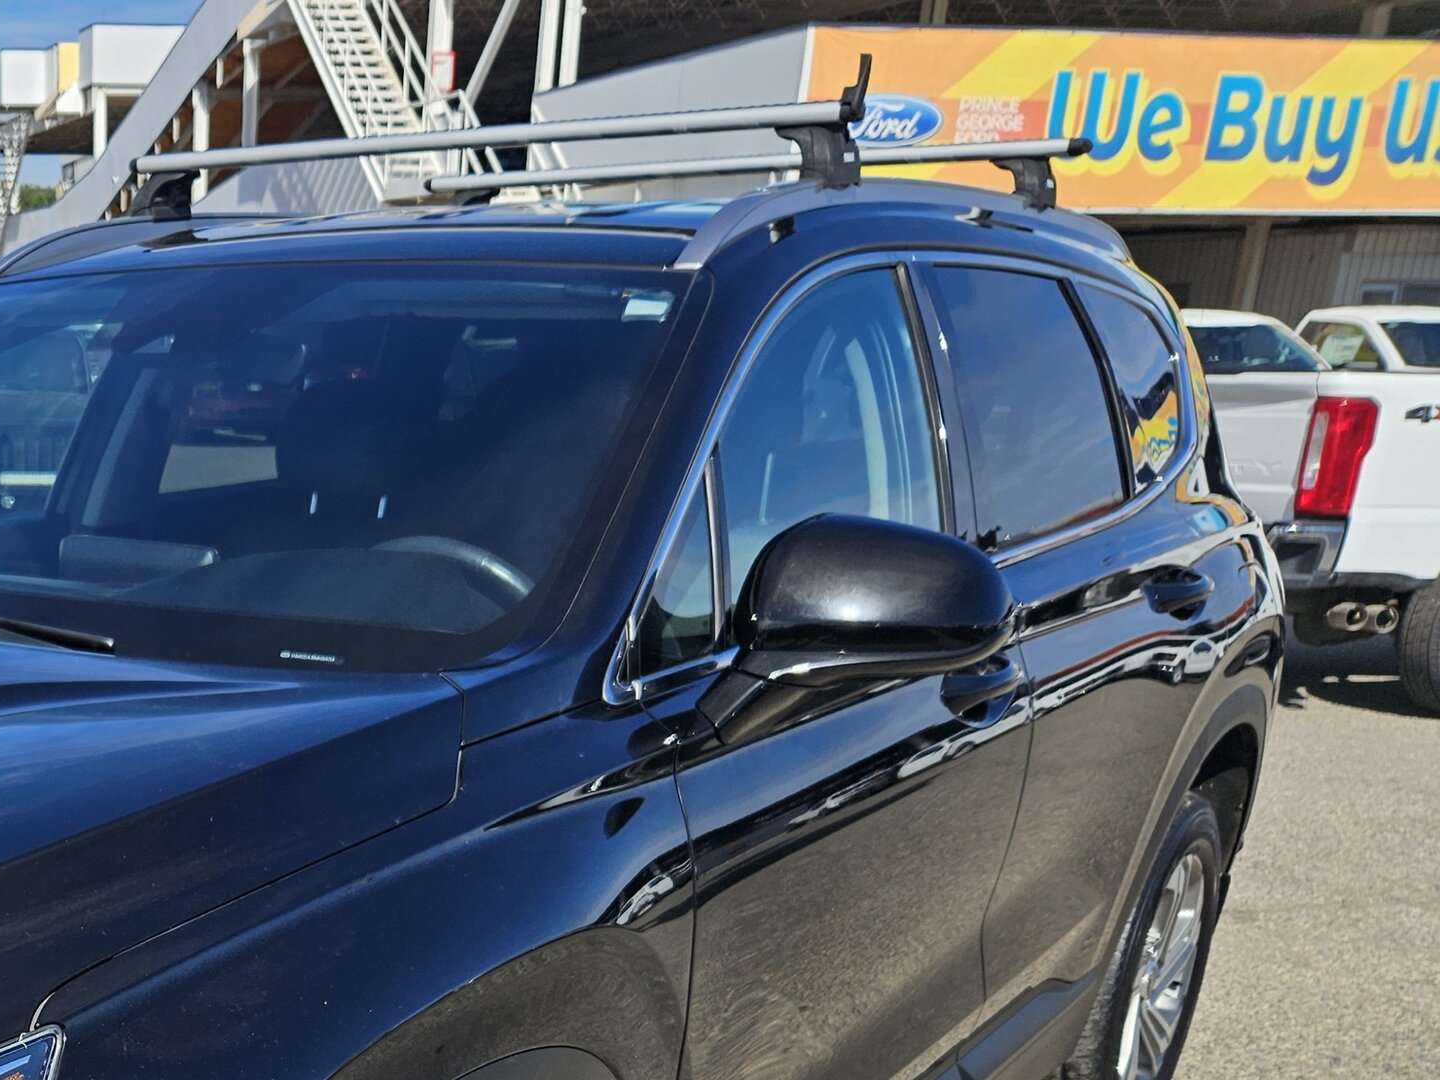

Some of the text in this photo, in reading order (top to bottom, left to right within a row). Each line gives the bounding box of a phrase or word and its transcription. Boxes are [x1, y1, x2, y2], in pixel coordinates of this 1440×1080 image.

[960, 96, 1020, 113] PRINCE
[848, 100, 922, 139] Ford
[956, 112, 1024, 132] GEORGE
[1048, 70, 1440, 187] We Buy U
